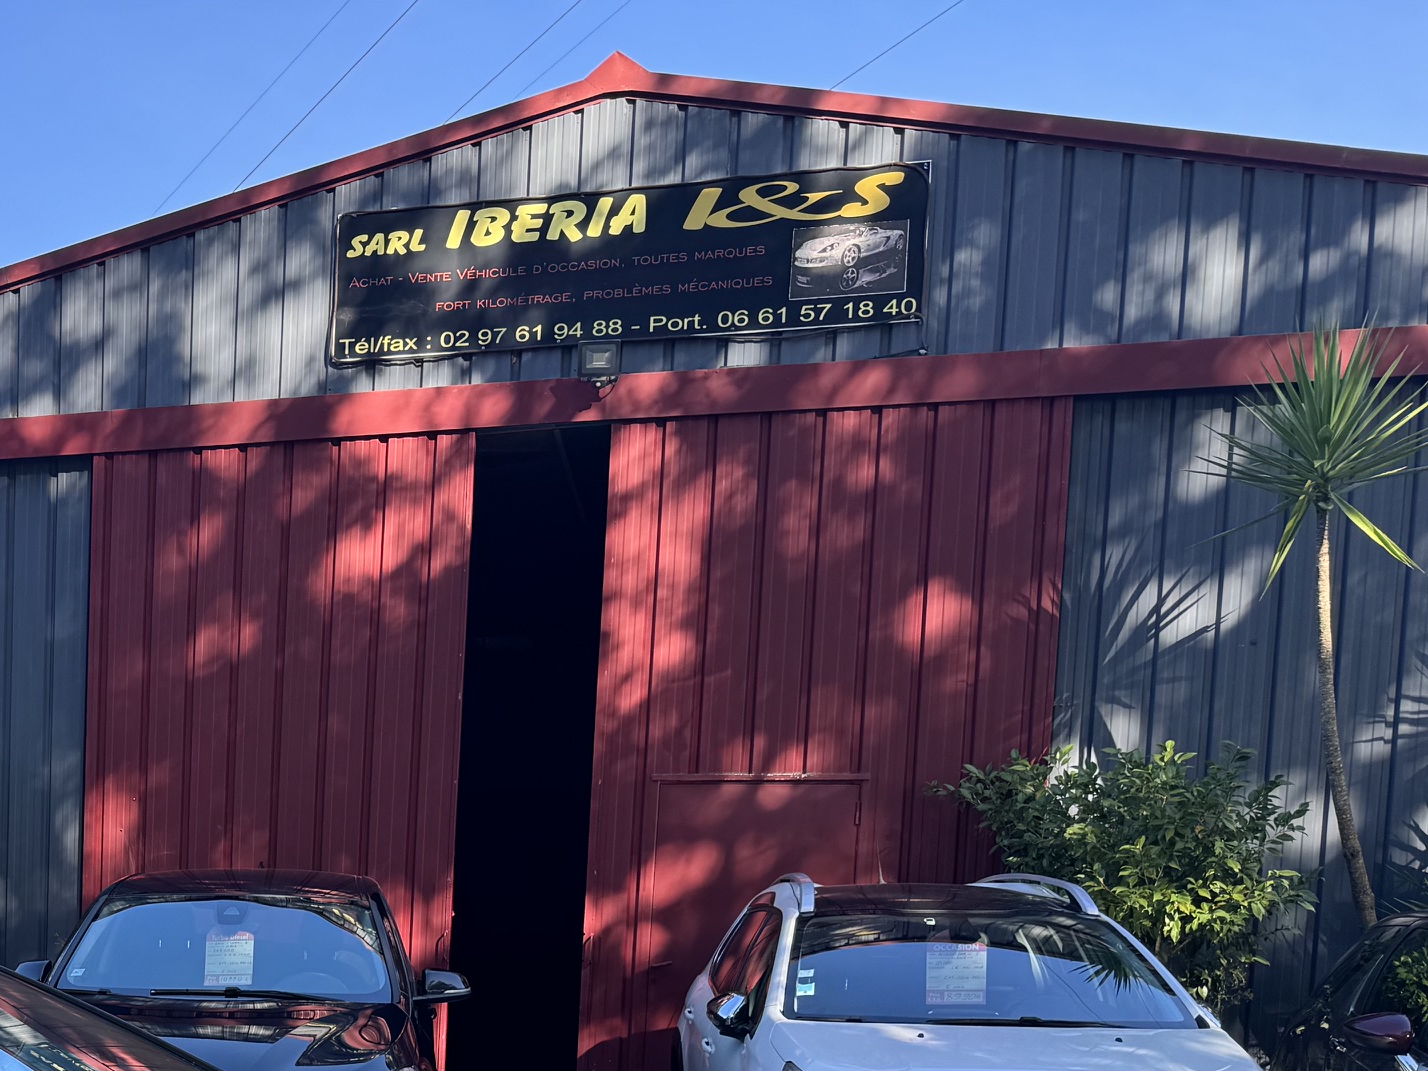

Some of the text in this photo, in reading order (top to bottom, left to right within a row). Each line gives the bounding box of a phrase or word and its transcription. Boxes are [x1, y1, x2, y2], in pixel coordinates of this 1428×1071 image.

[346, 229, 426, 258] SARL
[445, 194, 647, 250] IBERIA
[632, 252, 687, 266] TOUTES
[694, 245, 766, 261] MARQUES
[435, 276, 773, 312] FORT KILOMÉTRAGE, PROBLÈMES MÉCANIQUES
[339, 335, 418, 355] Tél/fax
[439, 330, 470, 348] 02
[477, 327, 507, 346] 97
[515, 324, 542, 342] 61
[554, 321, 583, 339] 94
[592, 319, 622, 336] 88
[649, 313, 707, 333] Port.
[717, 310, 749, 328] 06
[757, 307, 787, 325] 61
[799, 303, 832, 322] 57
[843, 300, 874, 319] 18
[883, 297, 917, 315] 40
